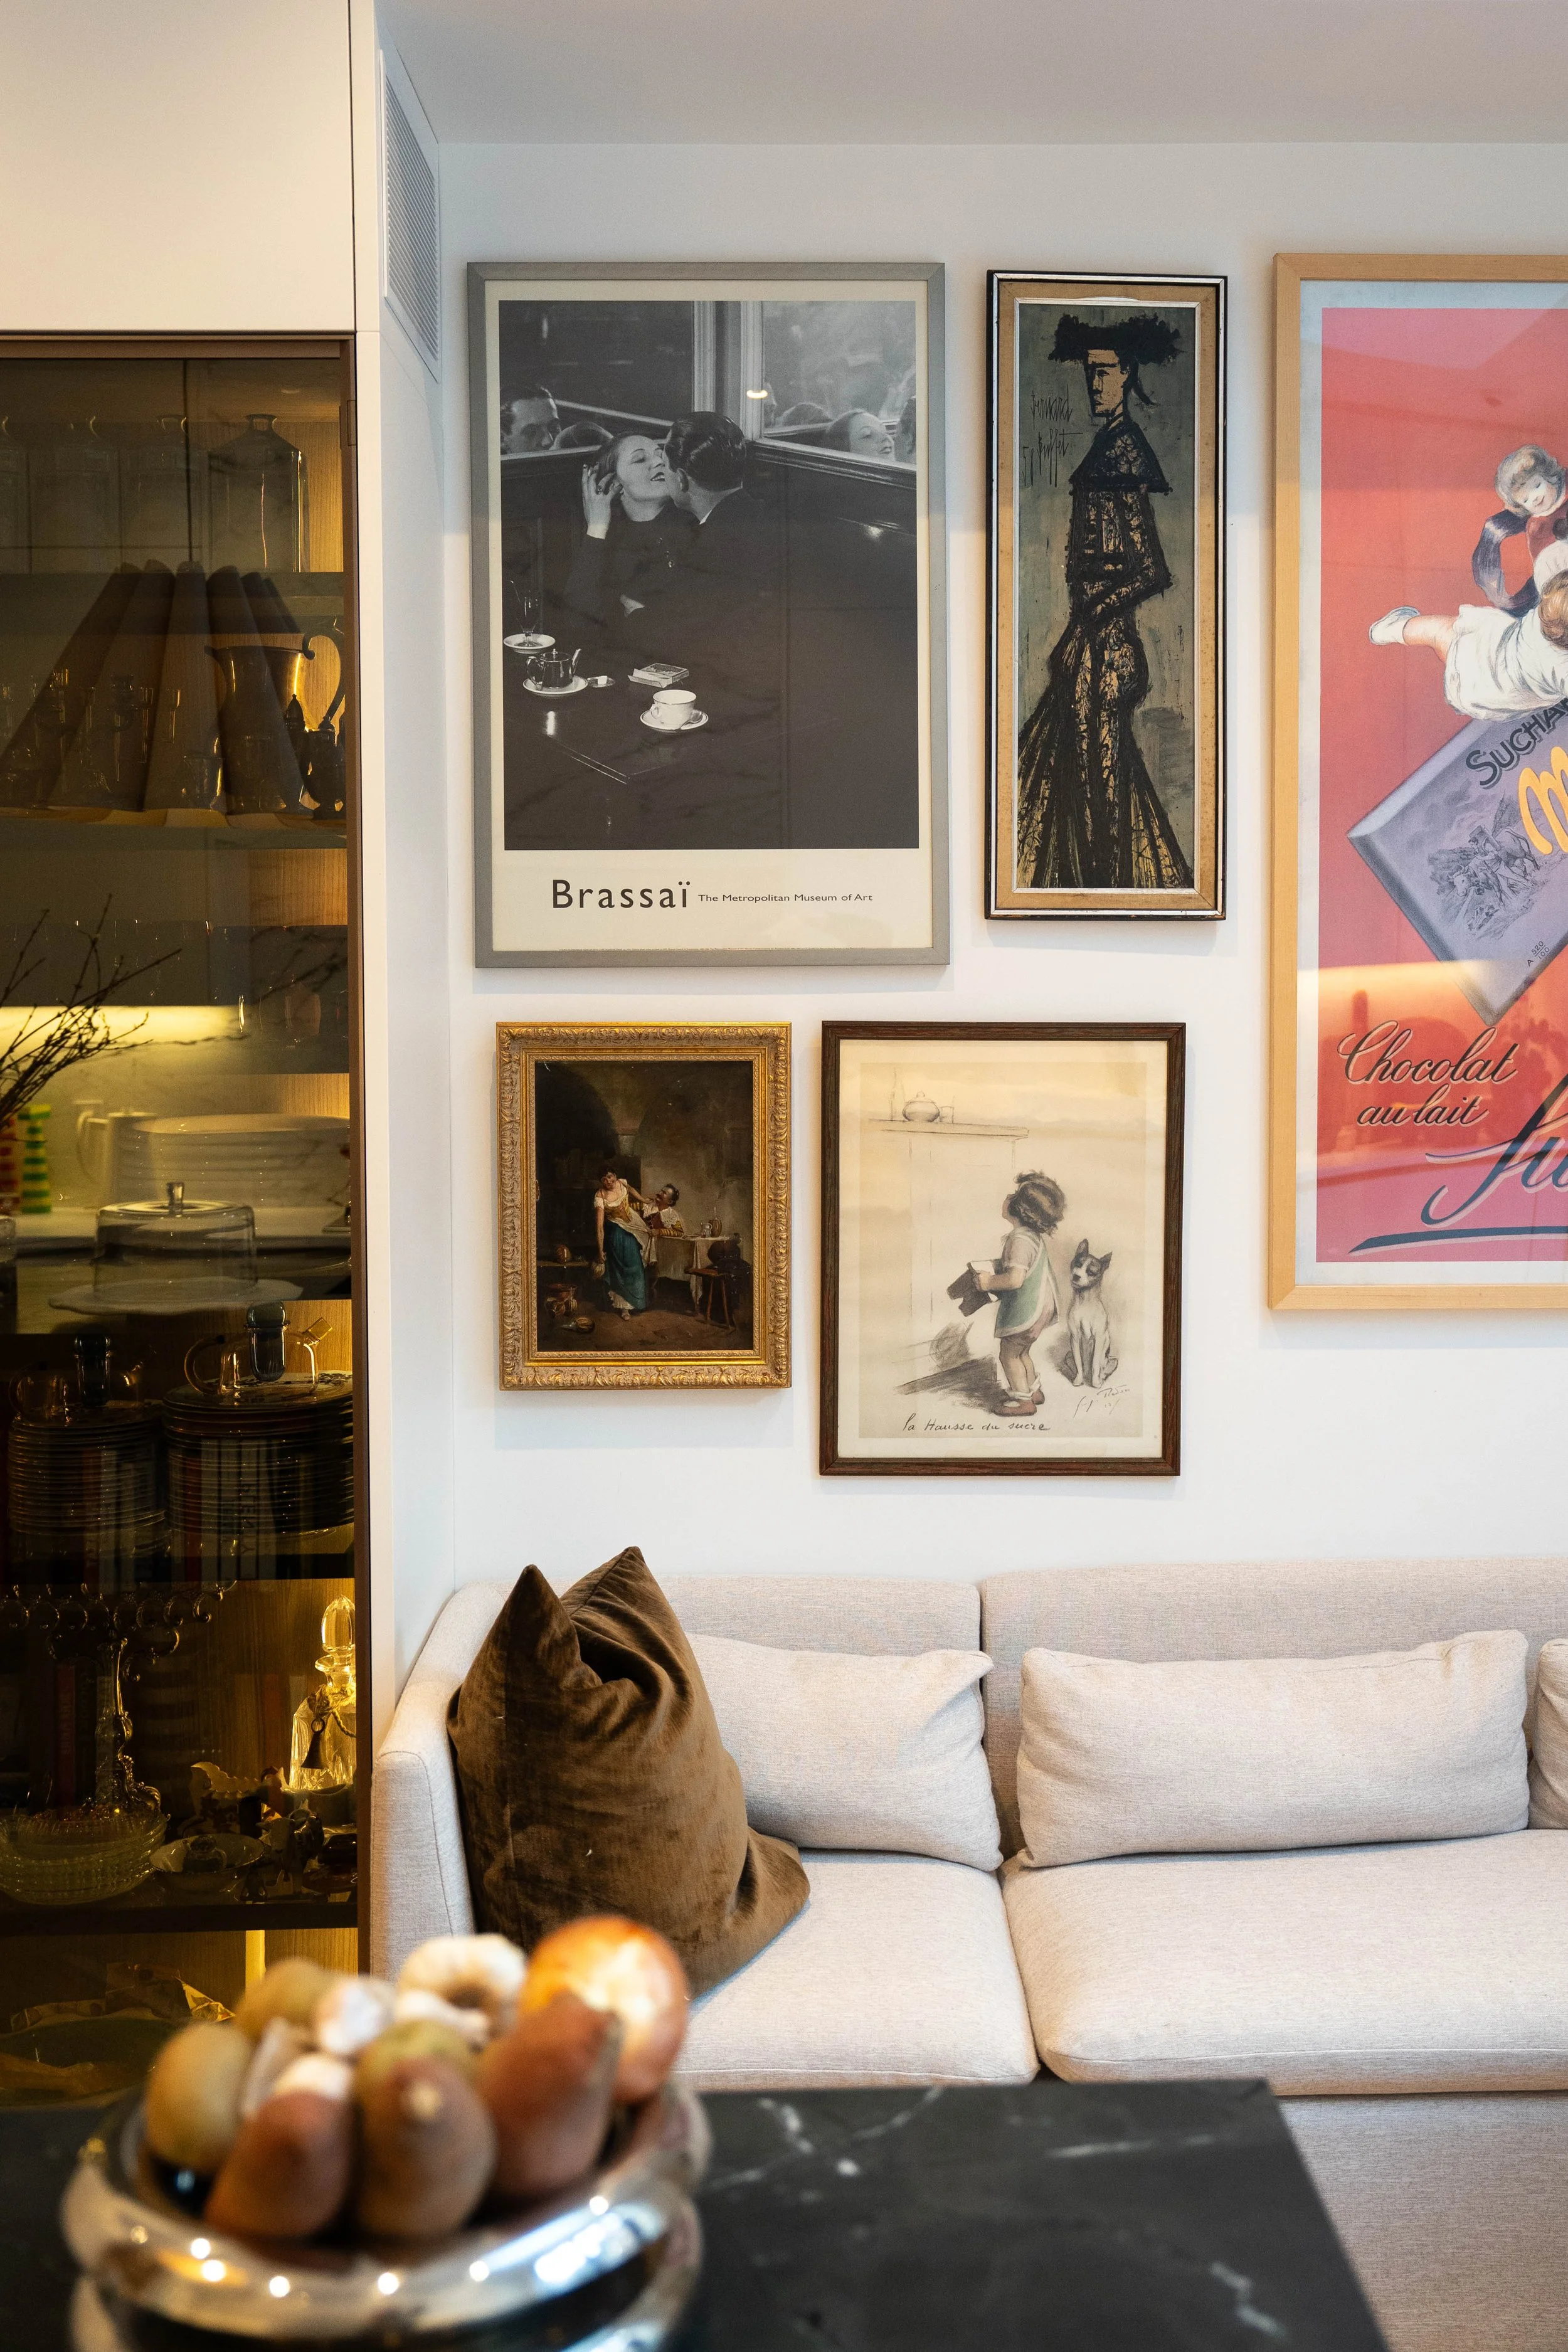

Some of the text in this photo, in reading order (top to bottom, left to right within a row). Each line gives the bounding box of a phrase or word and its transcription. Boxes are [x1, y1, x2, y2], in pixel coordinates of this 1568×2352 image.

[552, 879, 873, 909] Brassaï The Metropolitan Museum of Art
[1337, 1020, 1520, 1085] Chocolat
[1356, 1083, 1490, 1128] au lait
[924, 1418, 974, 1431] Hausse
[982, 1422, 1000, 1431] du
[1009, 1422, 1051, 1431] sucre
